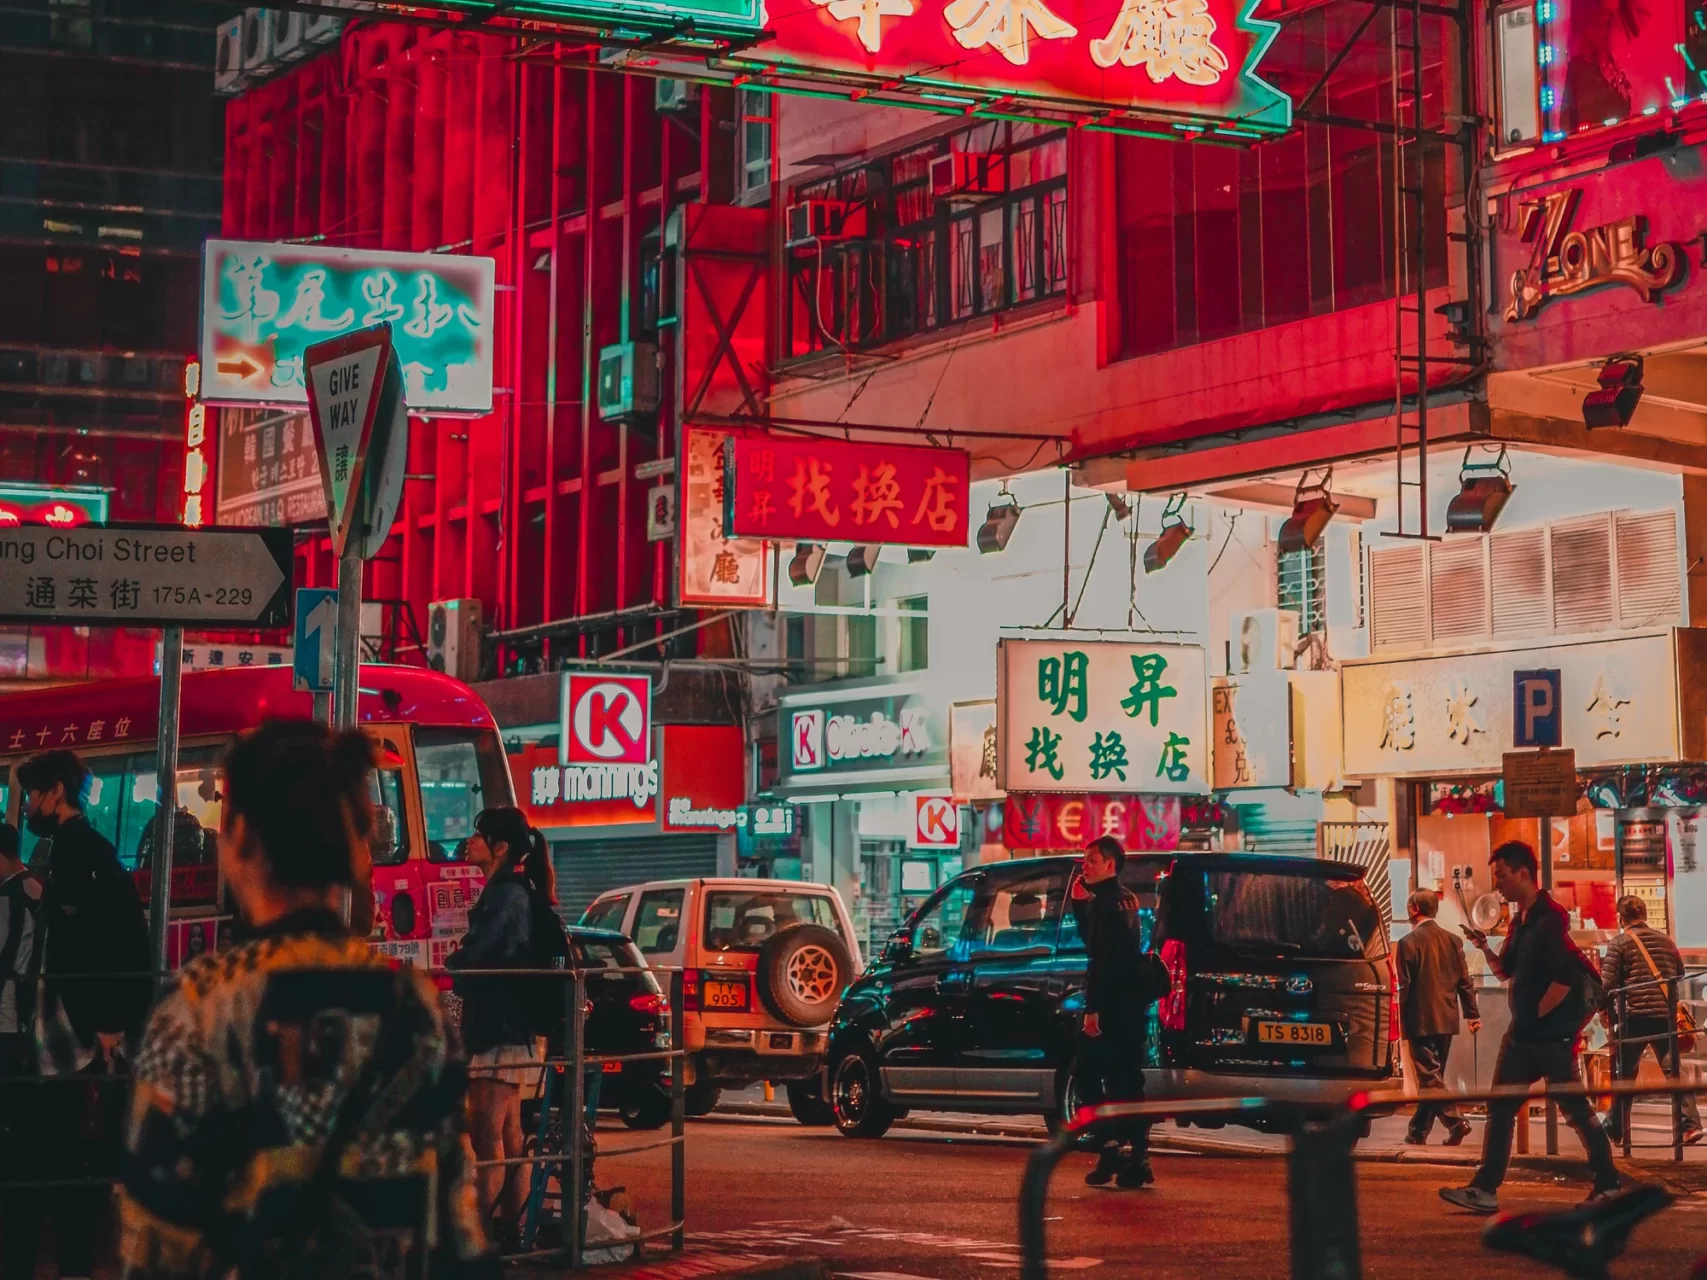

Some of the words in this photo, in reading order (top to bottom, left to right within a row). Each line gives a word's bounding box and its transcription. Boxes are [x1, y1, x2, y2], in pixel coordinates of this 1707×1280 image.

[330, 363, 360, 396] GIVE
[330, 398, 358, 430] WAY
[748, 449, 776, 527] 明昇
[786, 455, 959, 533] 找換店
[46, 536, 103, 562] Choi
[113, 538, 196, 563] Street
[26, 576, 140, 610] 通菜街
[153, 586, 252, 606] 175A-229
[1038, 650, 1178, 727] 明昇
[1524, 678, 1553, 741] P
[9, 717, 131, 749] 士十六座位
[1024, 726, 1191, 782] 找換店
[1016, 803, 1042, 841] ¥
[1057, 802, 1085, 842] €
[1102, 802, 1127, 840] £
[1145, 803, 1169, 842] $
[711, 994, 739, 1006] 905
[716, 983, 734, 994] TY
[1264, 1024, 1285, 1039] TS
[1290, 1026, 1325, 1042] 8318
